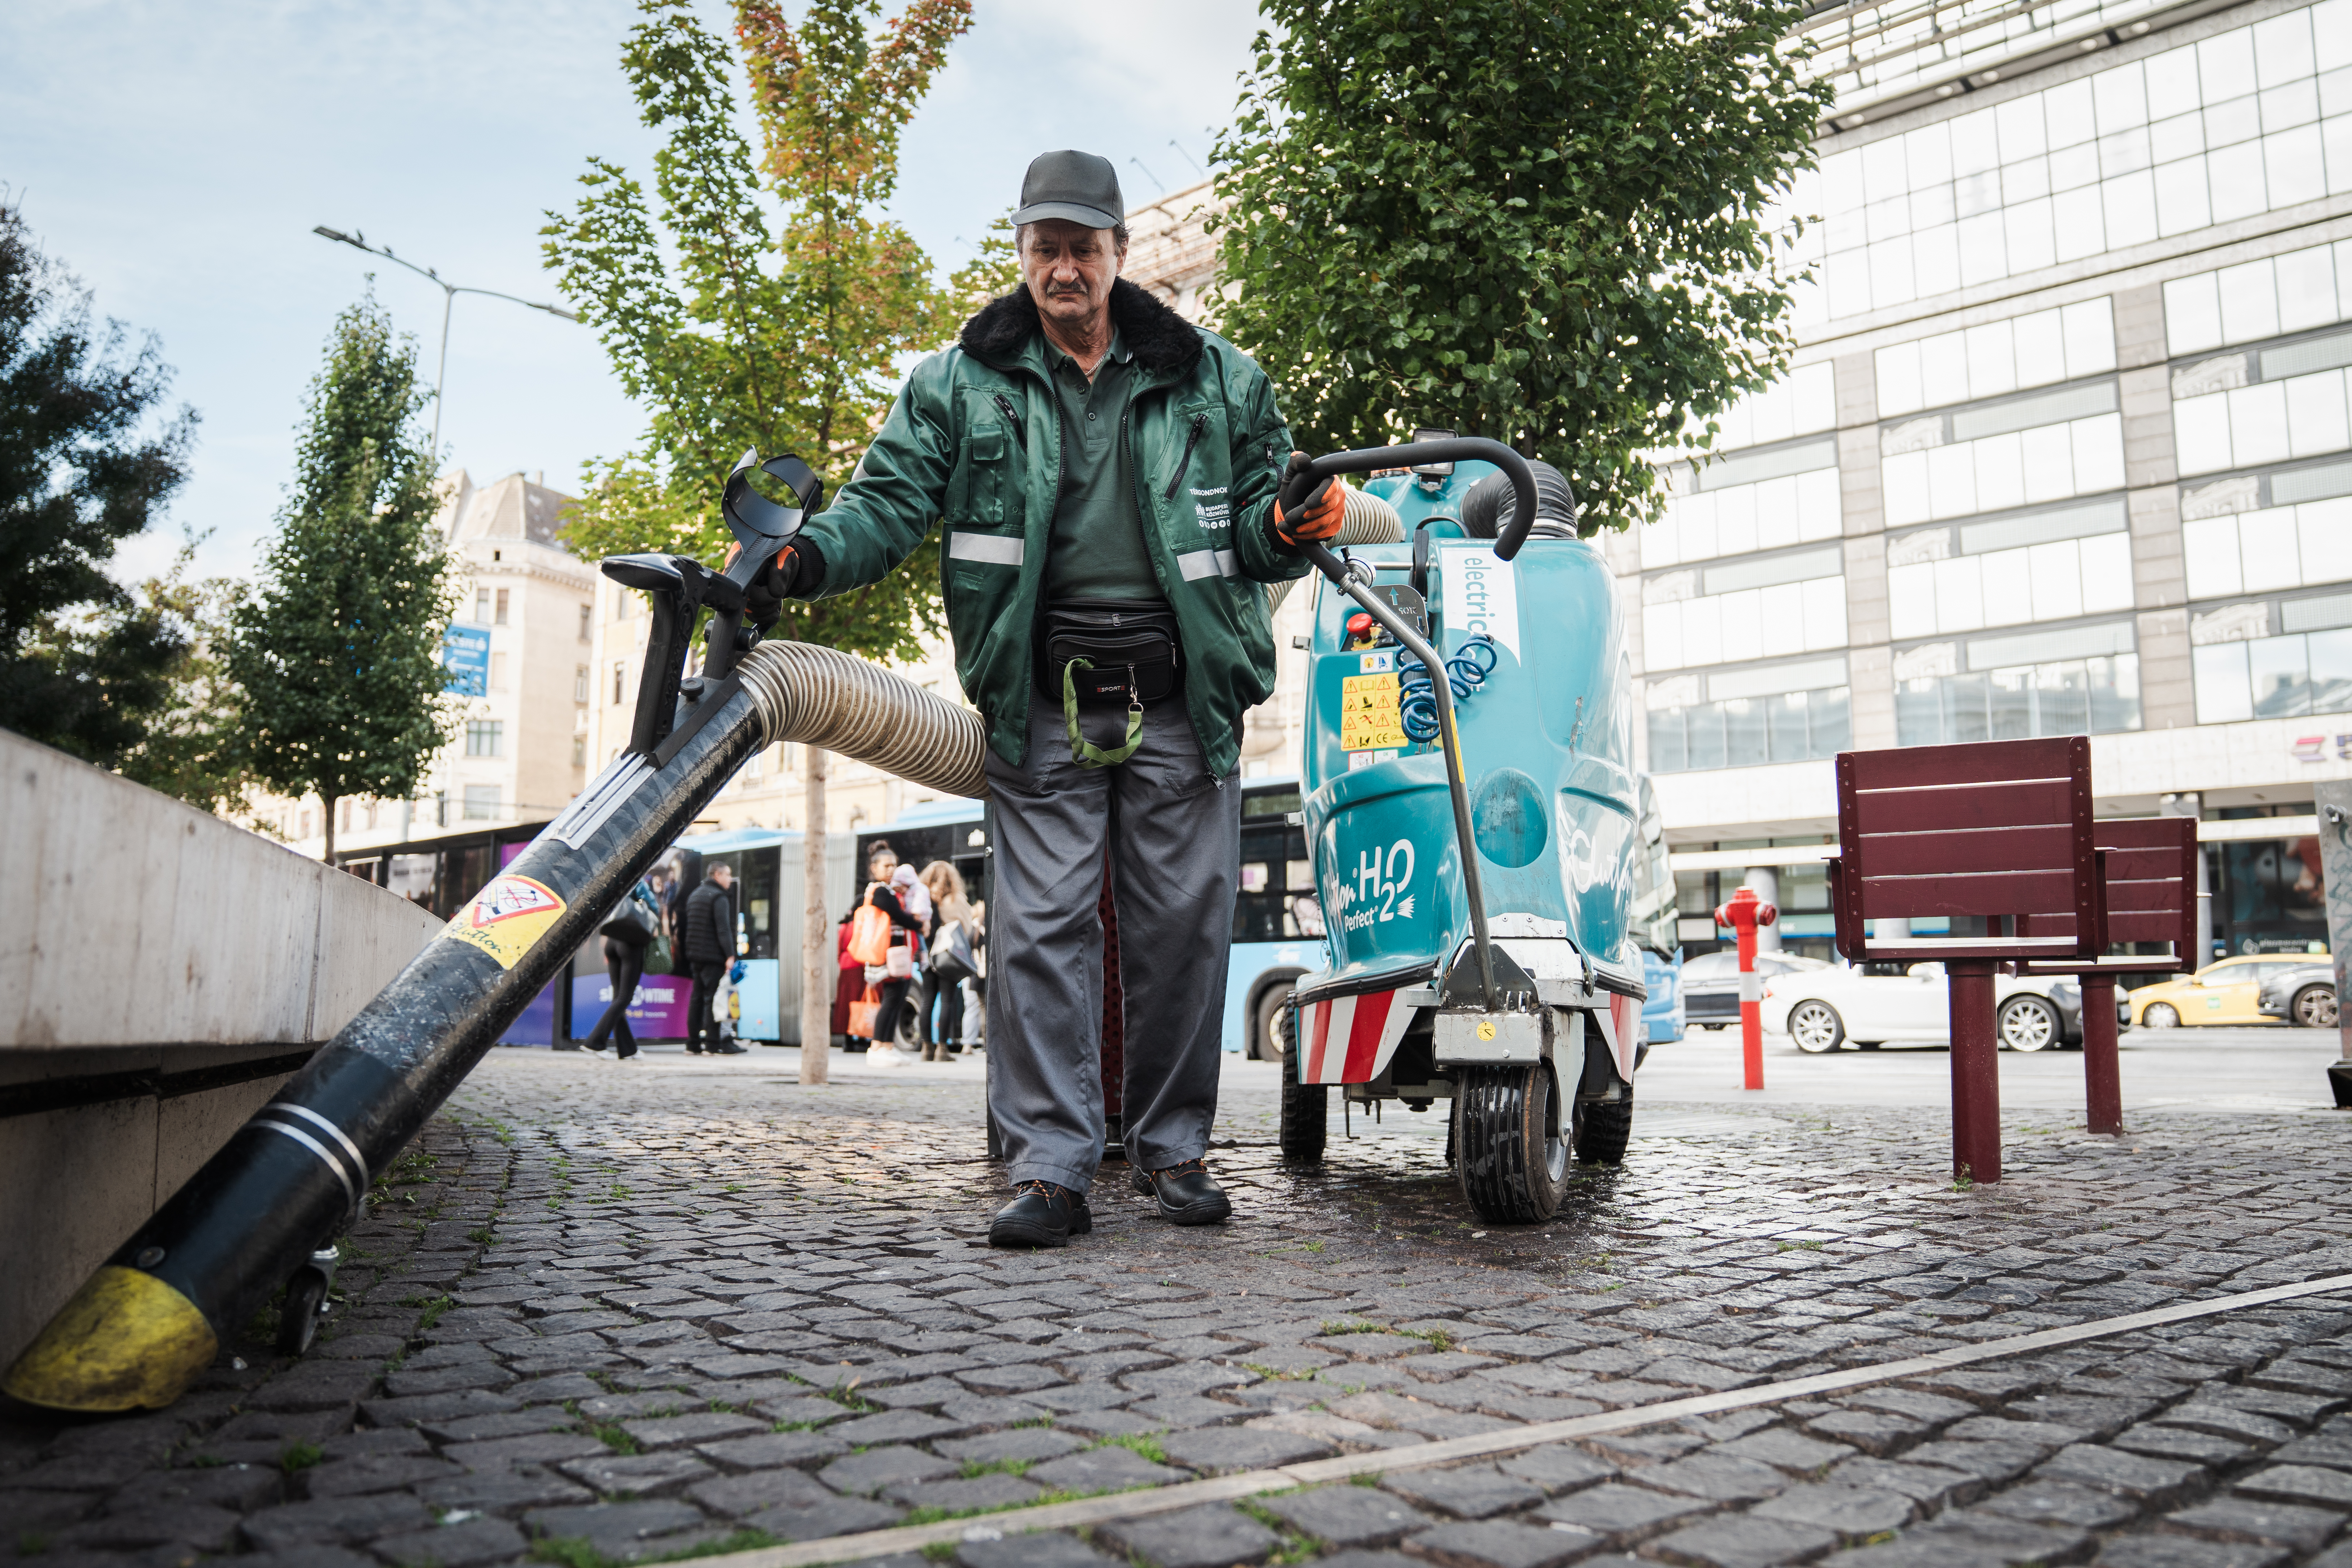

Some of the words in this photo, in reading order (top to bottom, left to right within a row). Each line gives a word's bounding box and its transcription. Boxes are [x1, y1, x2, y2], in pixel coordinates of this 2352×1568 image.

[1189, 486, 1228, 496] TÉRGONDNOK
[1206, 509, 1230, 517] KÖZMŰVEK
[1464, 557, 1496, 632] electric
